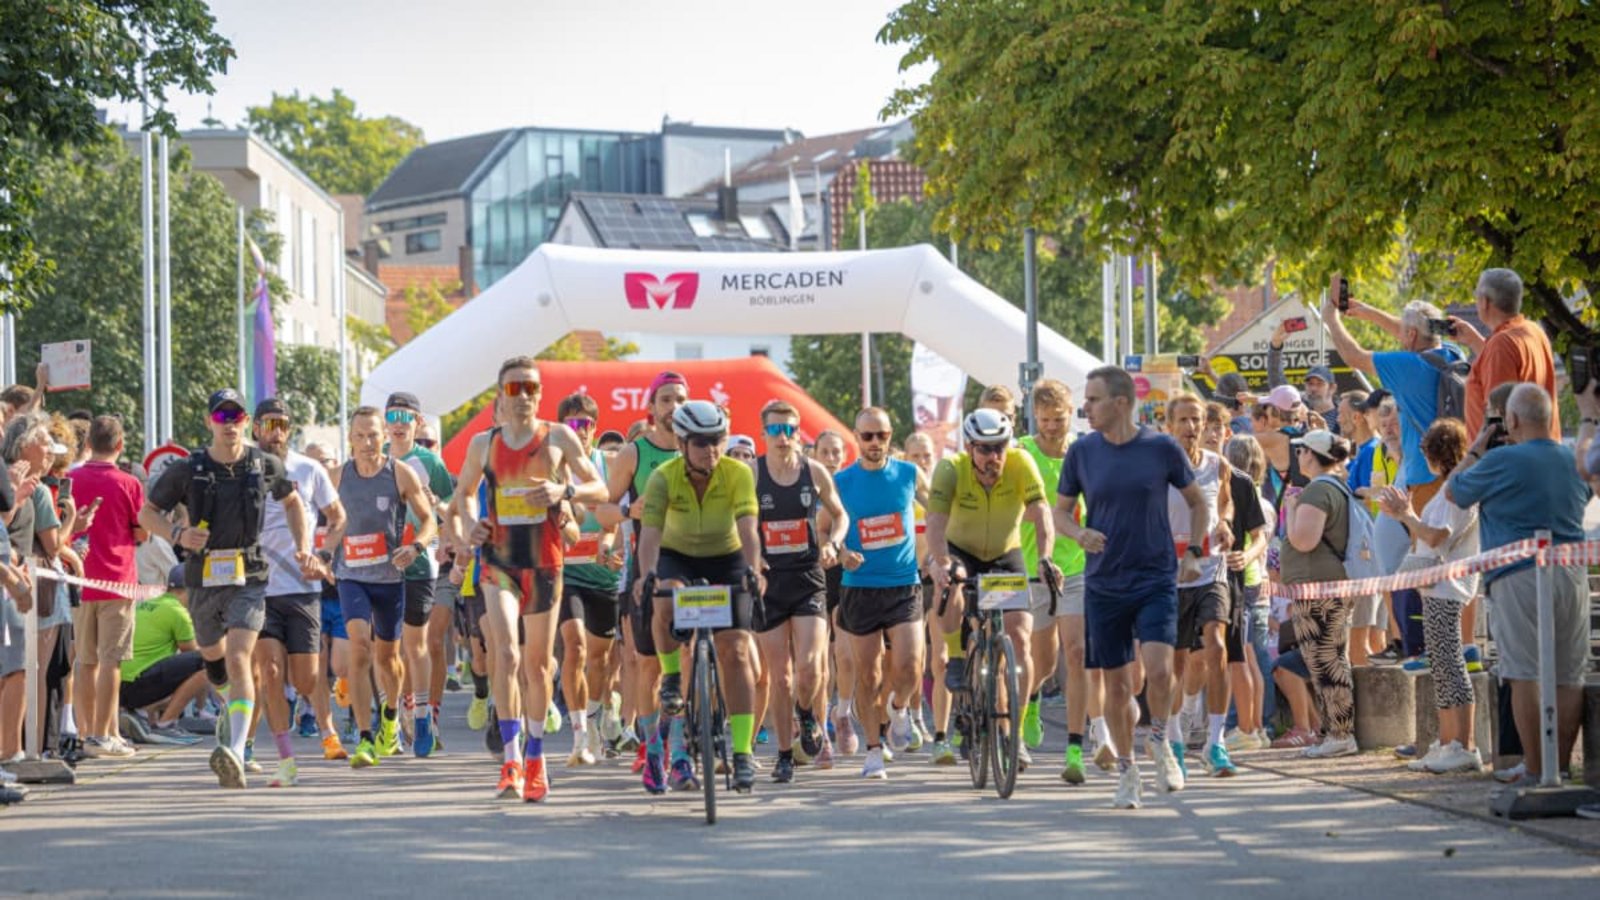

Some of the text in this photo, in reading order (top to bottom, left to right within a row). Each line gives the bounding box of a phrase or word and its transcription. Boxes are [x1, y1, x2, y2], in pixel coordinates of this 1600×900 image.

[721, 270, 843, 291] MERCADEN
[749, 293, 815, 306] BÖBLINGEN
[611, 386, 651, 411] STA
